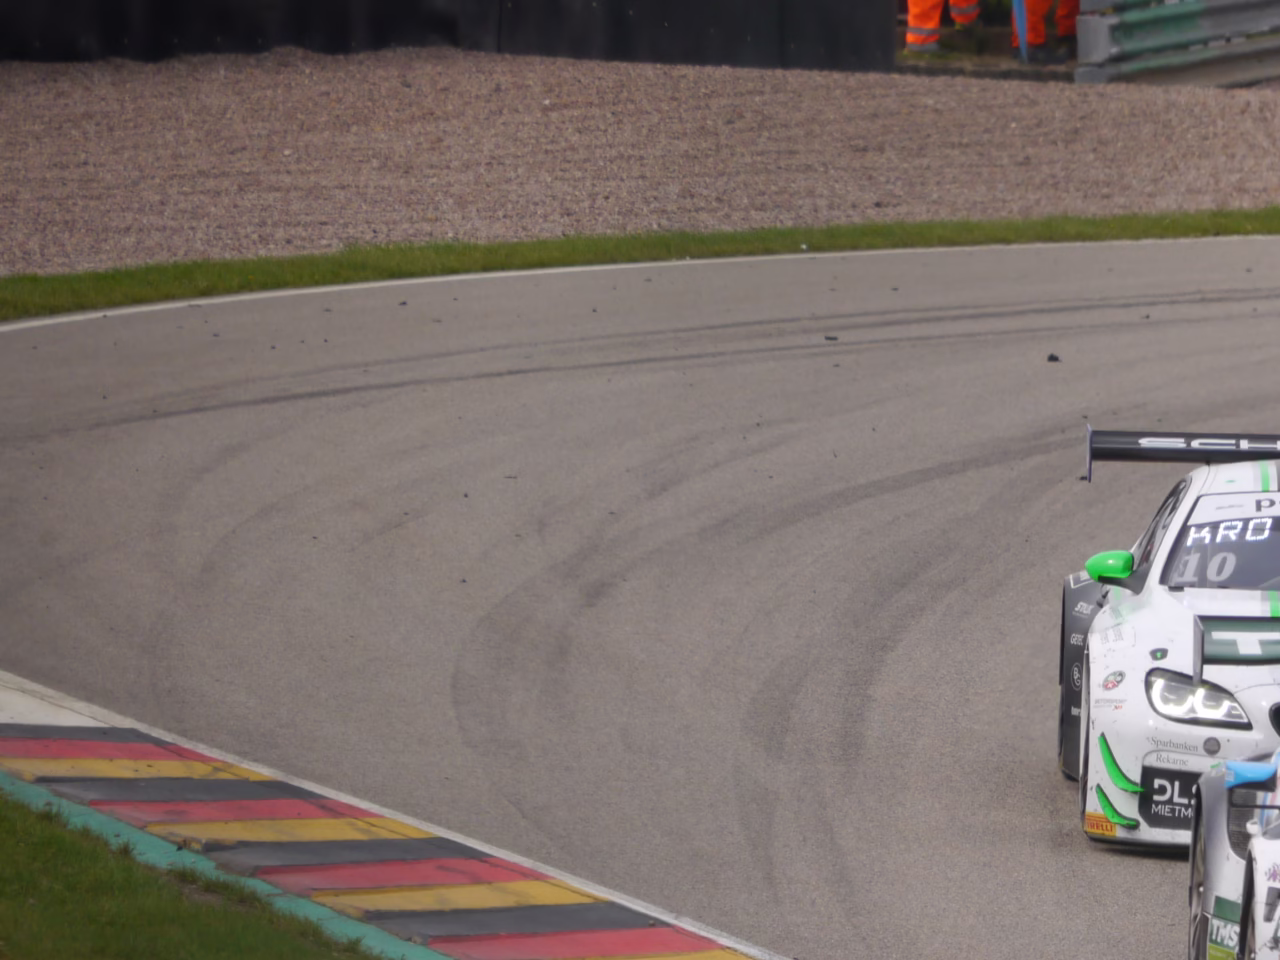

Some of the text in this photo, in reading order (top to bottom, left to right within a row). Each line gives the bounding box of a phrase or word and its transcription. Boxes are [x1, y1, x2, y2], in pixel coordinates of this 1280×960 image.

[1176, 550, 1237, 585] 10
[1151, 736, 1199, 752] Sparbanken
[1155, 754, 1189, 766] Rekarne
[1151, 803, 1193, 819] MIETM
[1086, 818, 1113, 832] IRELLI
[1211, 919, 1240, 948] TMS
